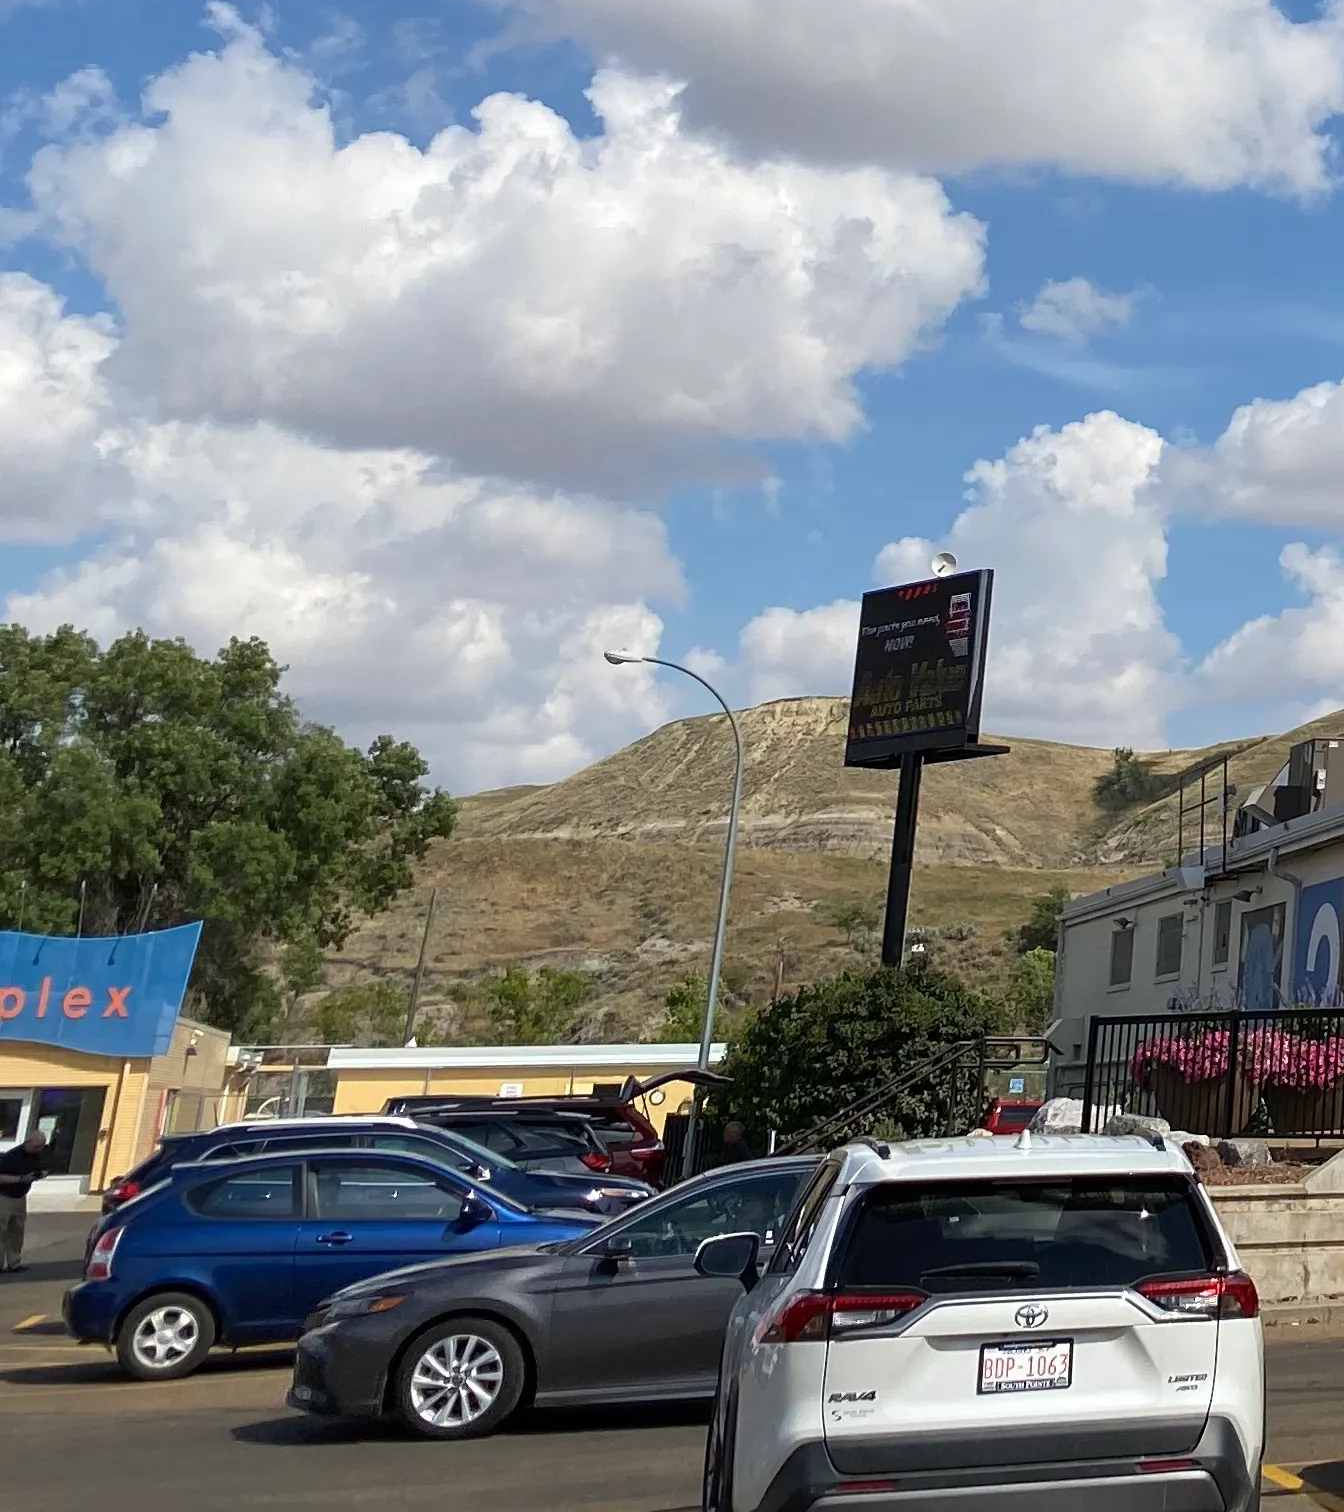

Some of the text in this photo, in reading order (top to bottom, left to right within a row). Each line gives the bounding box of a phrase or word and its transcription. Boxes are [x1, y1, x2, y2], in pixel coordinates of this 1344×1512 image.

[0, 976, 132, 1019] plex
[1001, 1379, 1051, 1391] SOUTH POINTE
[1168, 1373, 1208, 1384] LIMITED
[827, 1390, 877, 1404] RAV4
